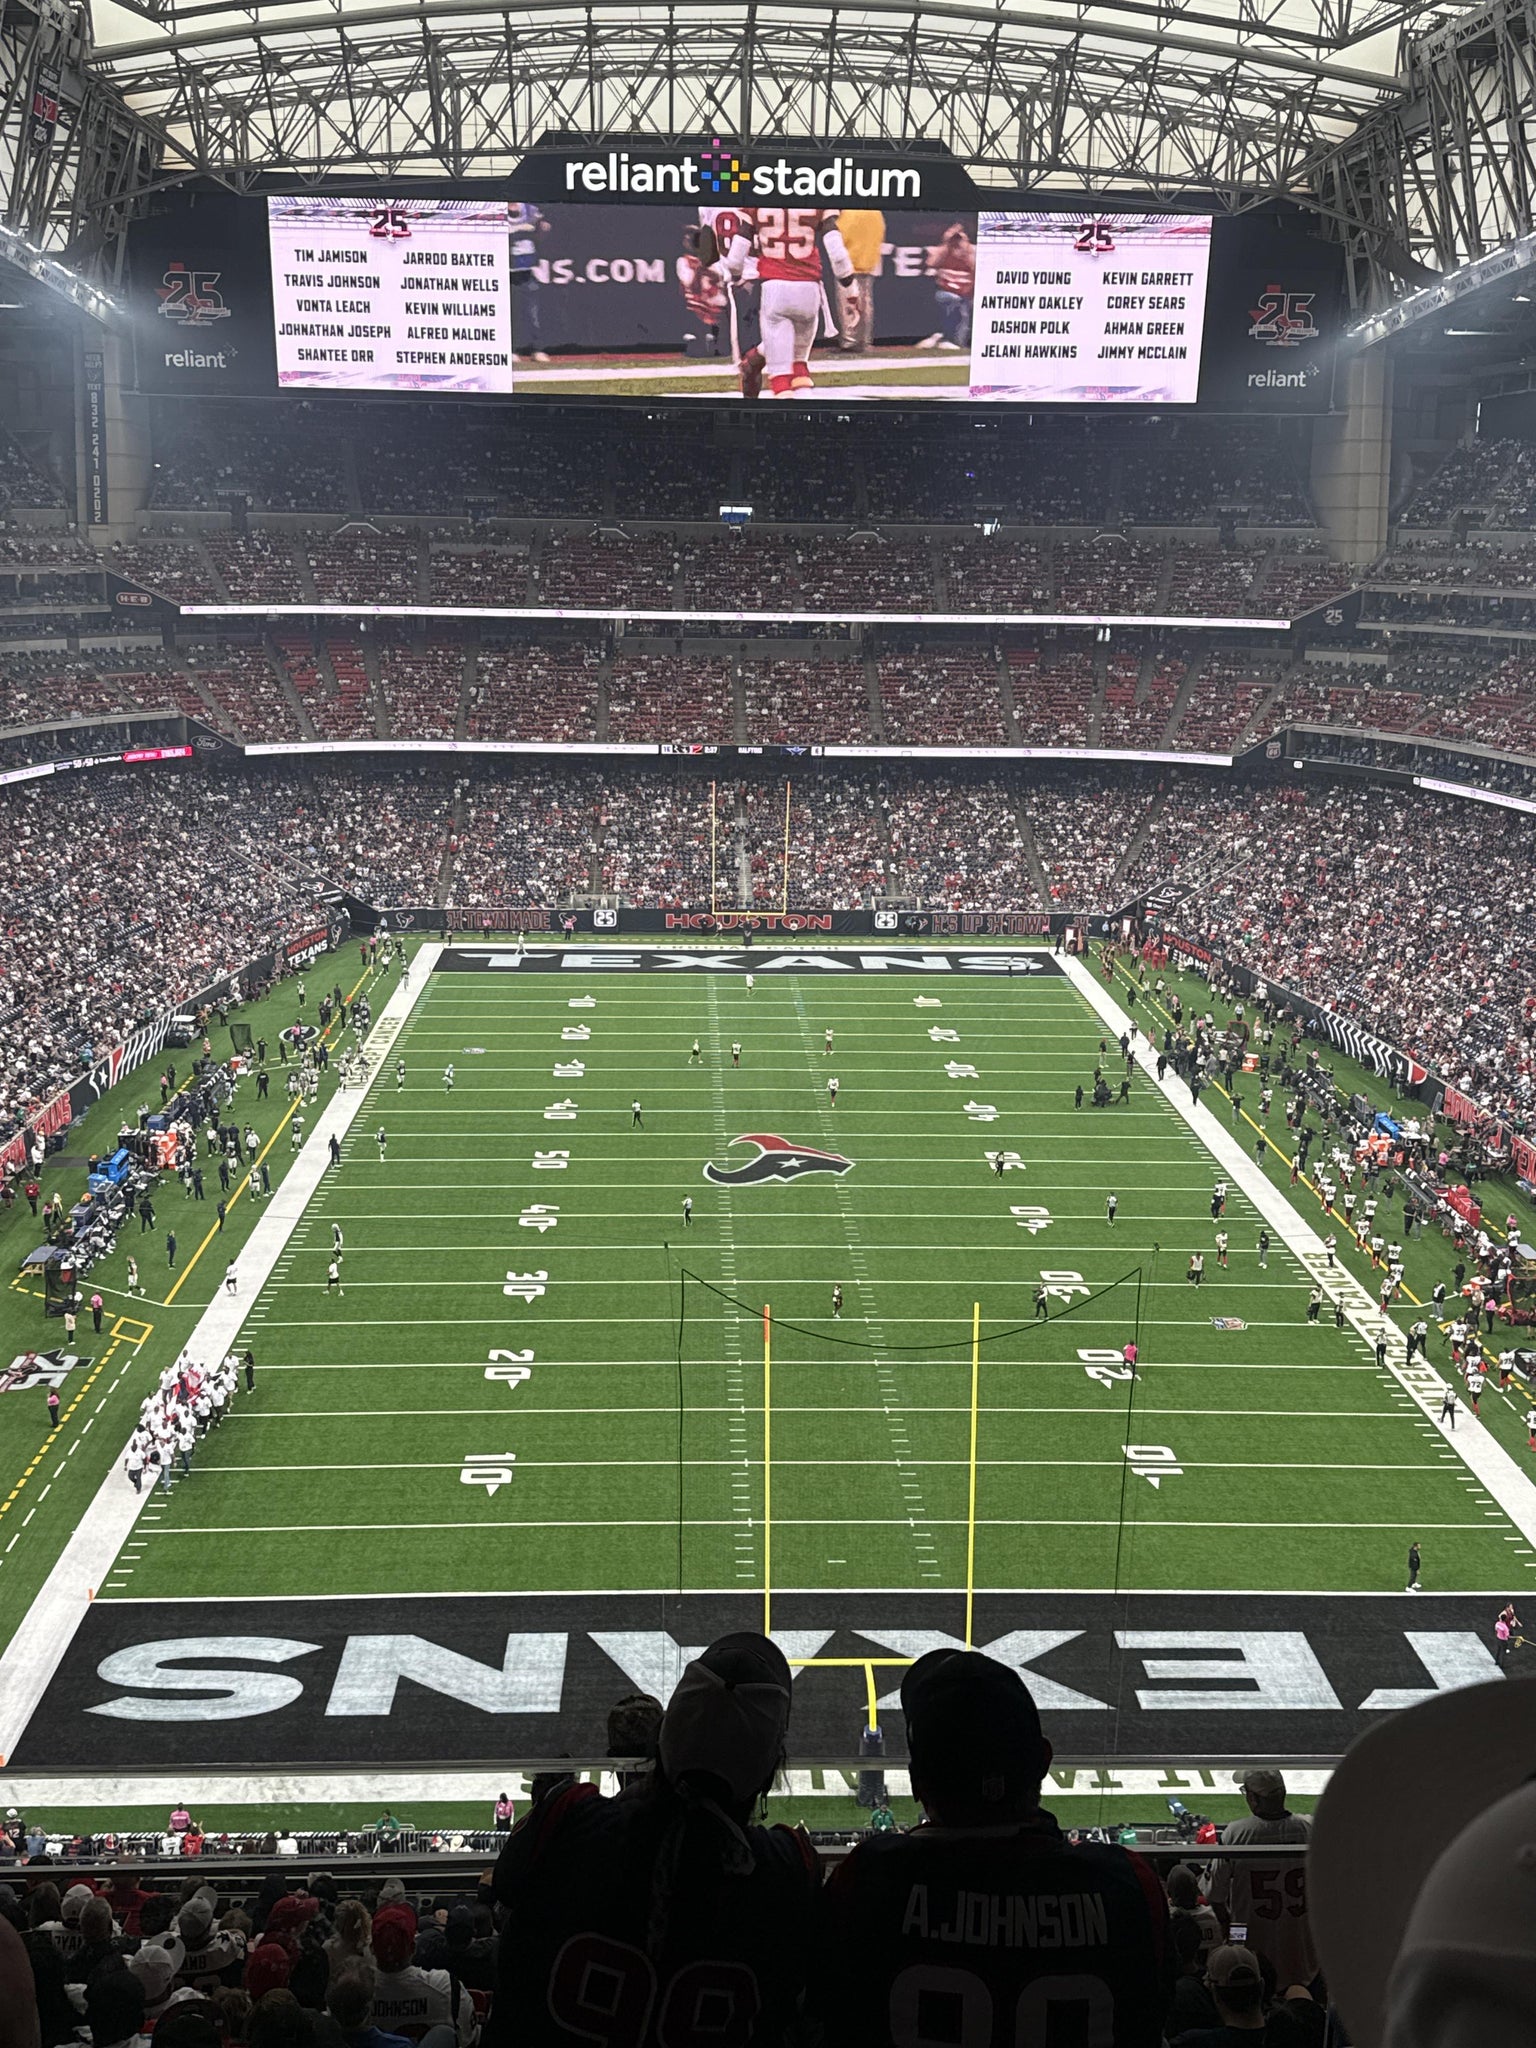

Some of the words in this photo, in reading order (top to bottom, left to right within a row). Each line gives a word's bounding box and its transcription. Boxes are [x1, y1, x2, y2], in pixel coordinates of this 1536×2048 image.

[566, 152, 700, 193] reliant
[752, 157, 921, 198] stadium
[373, 209, 408, 231] 25
[758, 208, 818, 259] 25
[1079, 224, 1113, 246] 25
[294, 249, 314, 262] TIM
[318, 250, 367, 263] JAMISON
[403, 252, 447, 266] JARROD
[451, 253, 494, 267] BAXTER
[284, 274, 323, 287] TRAVIS
[327, 275, 380, 288] JOHNSON
[400, 277, 458, 291] JONATHAN
[462, 279, 499, 292] WELLS
[996, 271, 1029, 284] DAVID
[1032, 271, 1071, 285] YOUNG
[1103, 272, 1137, 285] KEVIN
[1141, 272, 1194, 286] GARRETT
[163, 271, 222, 319] 25
[981, 296, 1035, 309] ANTHONY
[1038, 296, 1083, 310] OAKLEY
[1107, 296, 1145, 309] COREY
[1148, 296, 1185, 310] SEARS
[296, 299, 332, 312] VONTA
[336, 300, 370, 313] LEACH
[405, 302, 438, 315] KEVIN
[442, 303, 495, 316] WILLIAMS
[1258, 293, 1316, 339] 25
[279, 323, 343, 337] JOHNATHAN
[347, 325, 391, 338] JOSEPH
[407, 327, 448, 340] ALFRED
[452, 328, 496, 341] MALONE
[991, 321, 1036, 334] DASHON
[1040, 321, 1070, 334] POLK
[1104, 322, 1143, 335] AHMAN
[1147, 322, 1185, 336] GREEN
[165, 349, 226, 368] reliant
[298, 349, 348, 362] SHANTEE
[351, 349, 374, 362] ORR
[396, 351, 446, 364] STEPHEN
[450, 352, 508, 366] ANDERSON
[981, 345, 1020, 358] JELANI
[1024, 345, 1077, 358] HAWKINS
[1097, 346, 1134, 359] JIMMY
[1137, 346, 1187, 360] MCCLAIN
[1248, 369, 1306, 387] reliant
[197, 737, 217, 749] Ford
[510, 911, 550, 930] MADE
[597, 911, 614, 925] 25
[666, 913, 832, 930] HOUSTON
[878, 913, 895, 927] 25
[962, 915, 984, 933] UP
[1007, 915, 1050, 934] TOWN
[287, 929, 327, 956] HOUSTON
[1163, 933, 1212, 962] HOUSTON
[288, 939, 328, 967] TEXANS
[457, 953, 1043, 971] TEXANS
[532, 1150, 570, 1169] 50
[518, 1204, 560, 1227] 40
[1009, 1205, 1054, 1228] 40
[503, 1270, 548, 1295] 30
[1039, 1270, 1091, 1296] 30
[1303, 1252, 1373, 1312] CANCER
[484, 1349, 534, 1380] 20
[1076, 1349, 1142, 1381] 20
[460, 1451, 516, 1484] 10
[1121, 1444, 1184, 1476] 10
[901, 1883, 1109, 1949] A.JOHNSON
[371, 1998, 427, 2016] JOHNSON
